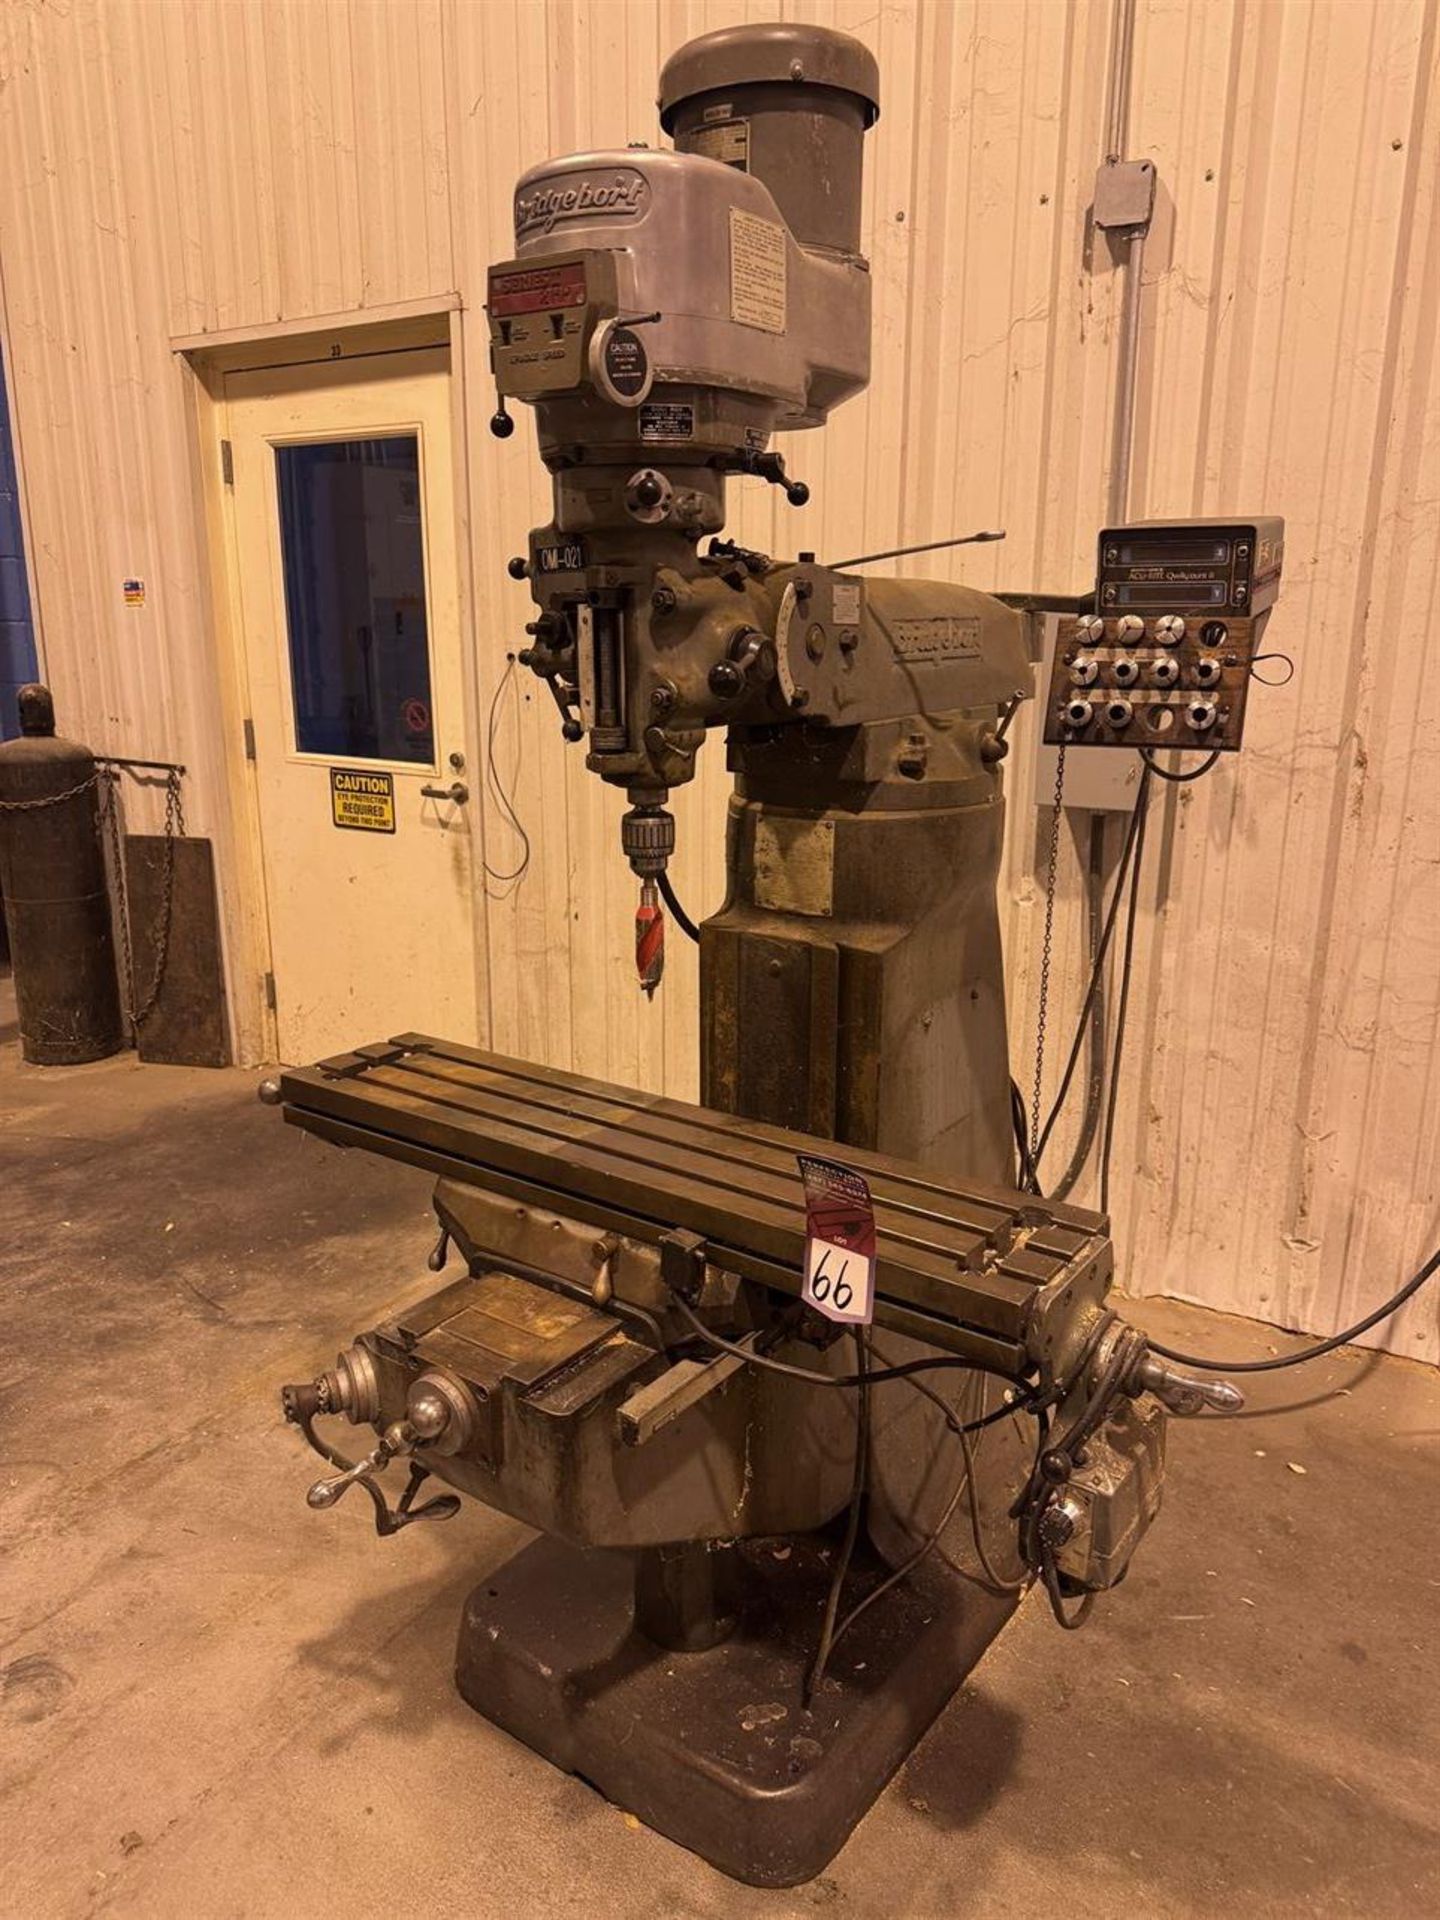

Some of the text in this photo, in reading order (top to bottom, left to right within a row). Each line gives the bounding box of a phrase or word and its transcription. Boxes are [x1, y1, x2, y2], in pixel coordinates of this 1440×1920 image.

[335, 774, 389, 794] CAUTION
[350, 793, 388, 805] PROTECTION
[342, 802, 385, 817] REQUIRED
[812, 1249, 853, 1310] 66
